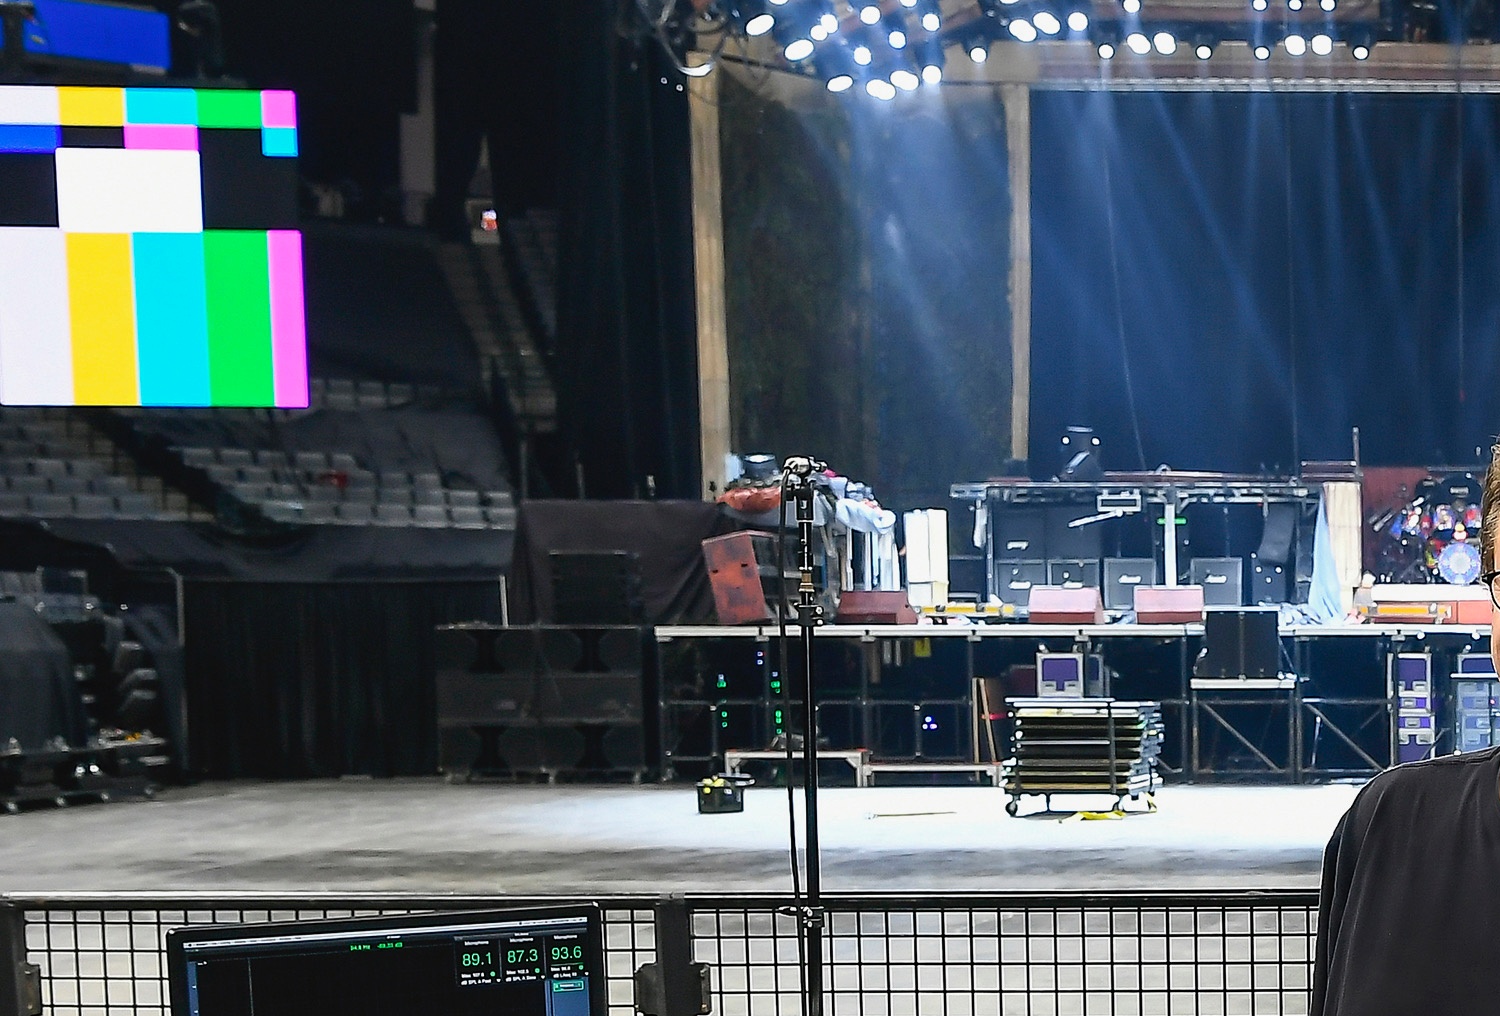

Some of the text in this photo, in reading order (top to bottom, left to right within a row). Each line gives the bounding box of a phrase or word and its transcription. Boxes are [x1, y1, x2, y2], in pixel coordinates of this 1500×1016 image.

[462, 952, 492, 967] 89.1
[507, 948, 538, 964] 87.3
[551, 945, 582, 961] 93.6
